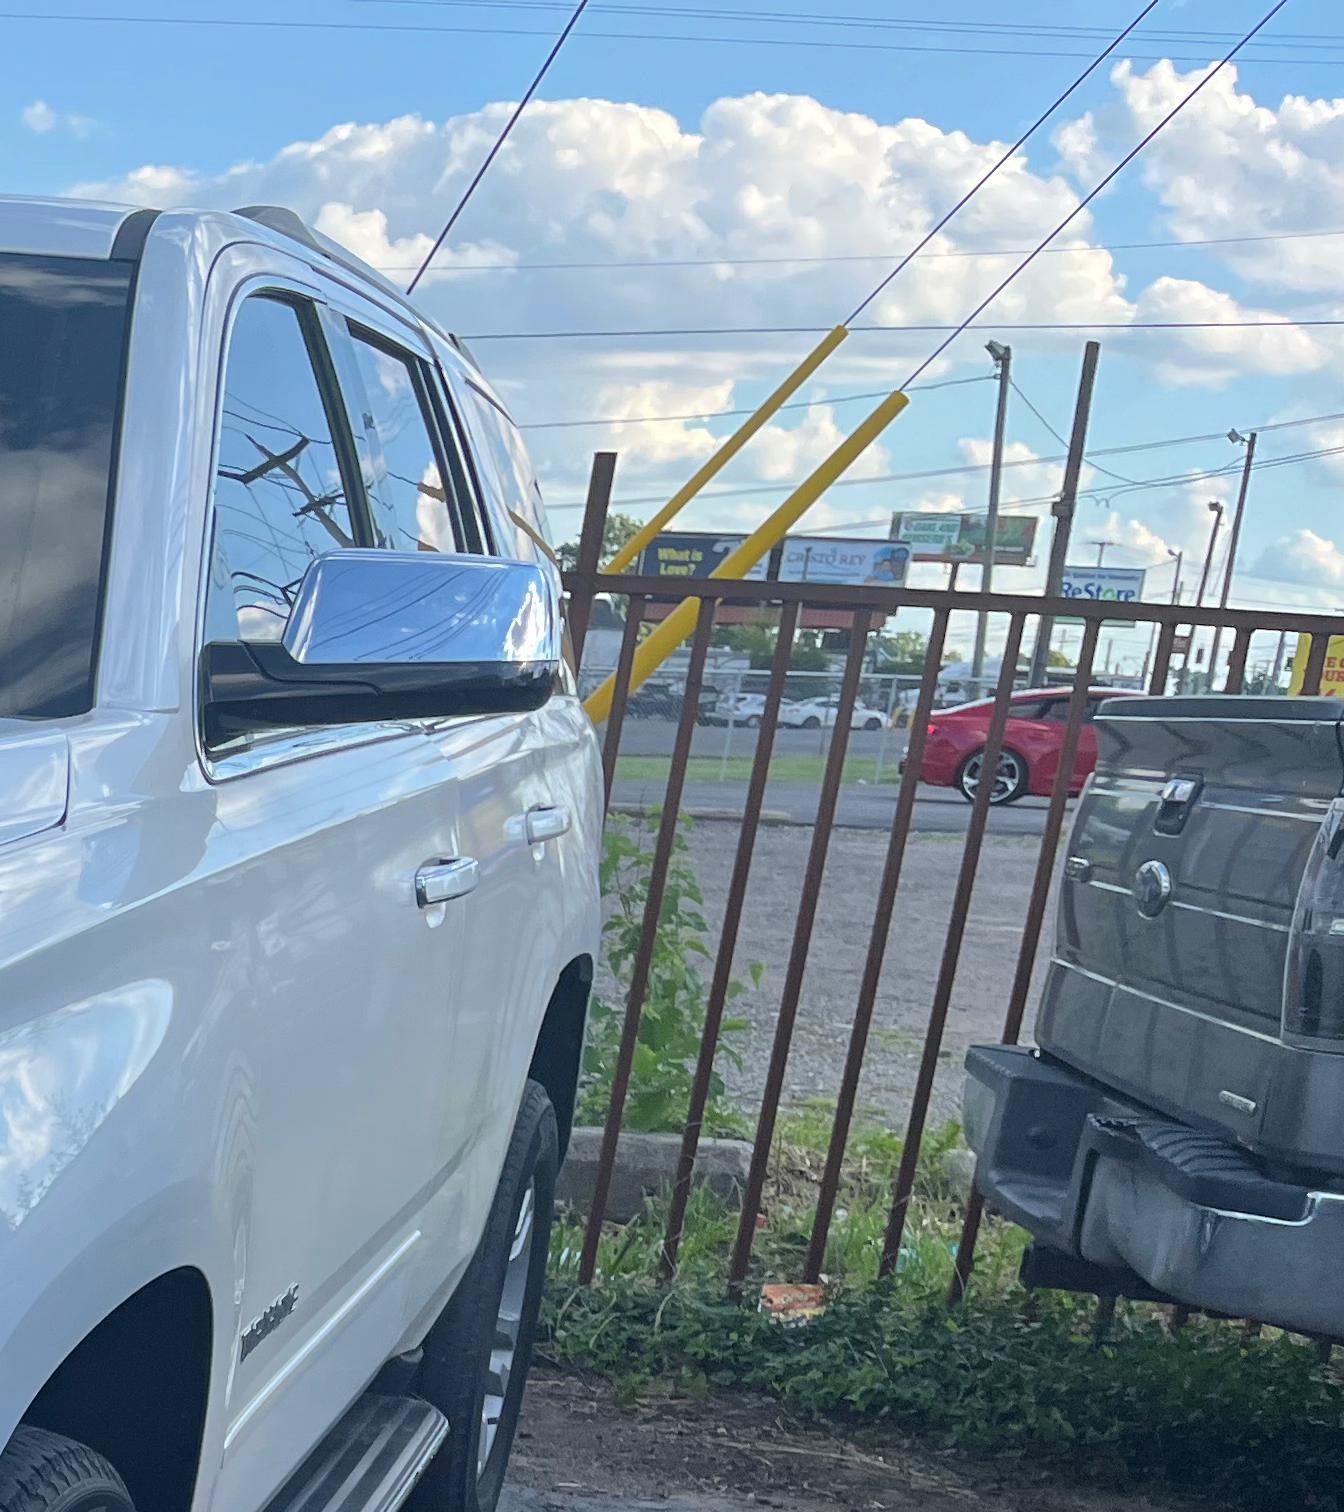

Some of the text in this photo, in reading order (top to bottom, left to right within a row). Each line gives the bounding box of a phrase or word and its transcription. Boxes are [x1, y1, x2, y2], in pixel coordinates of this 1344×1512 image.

[657, 547, 703, 561] What is
[787, 549, 866, 566] CRSTO REY
[659, 562, 696, 575] Love?
